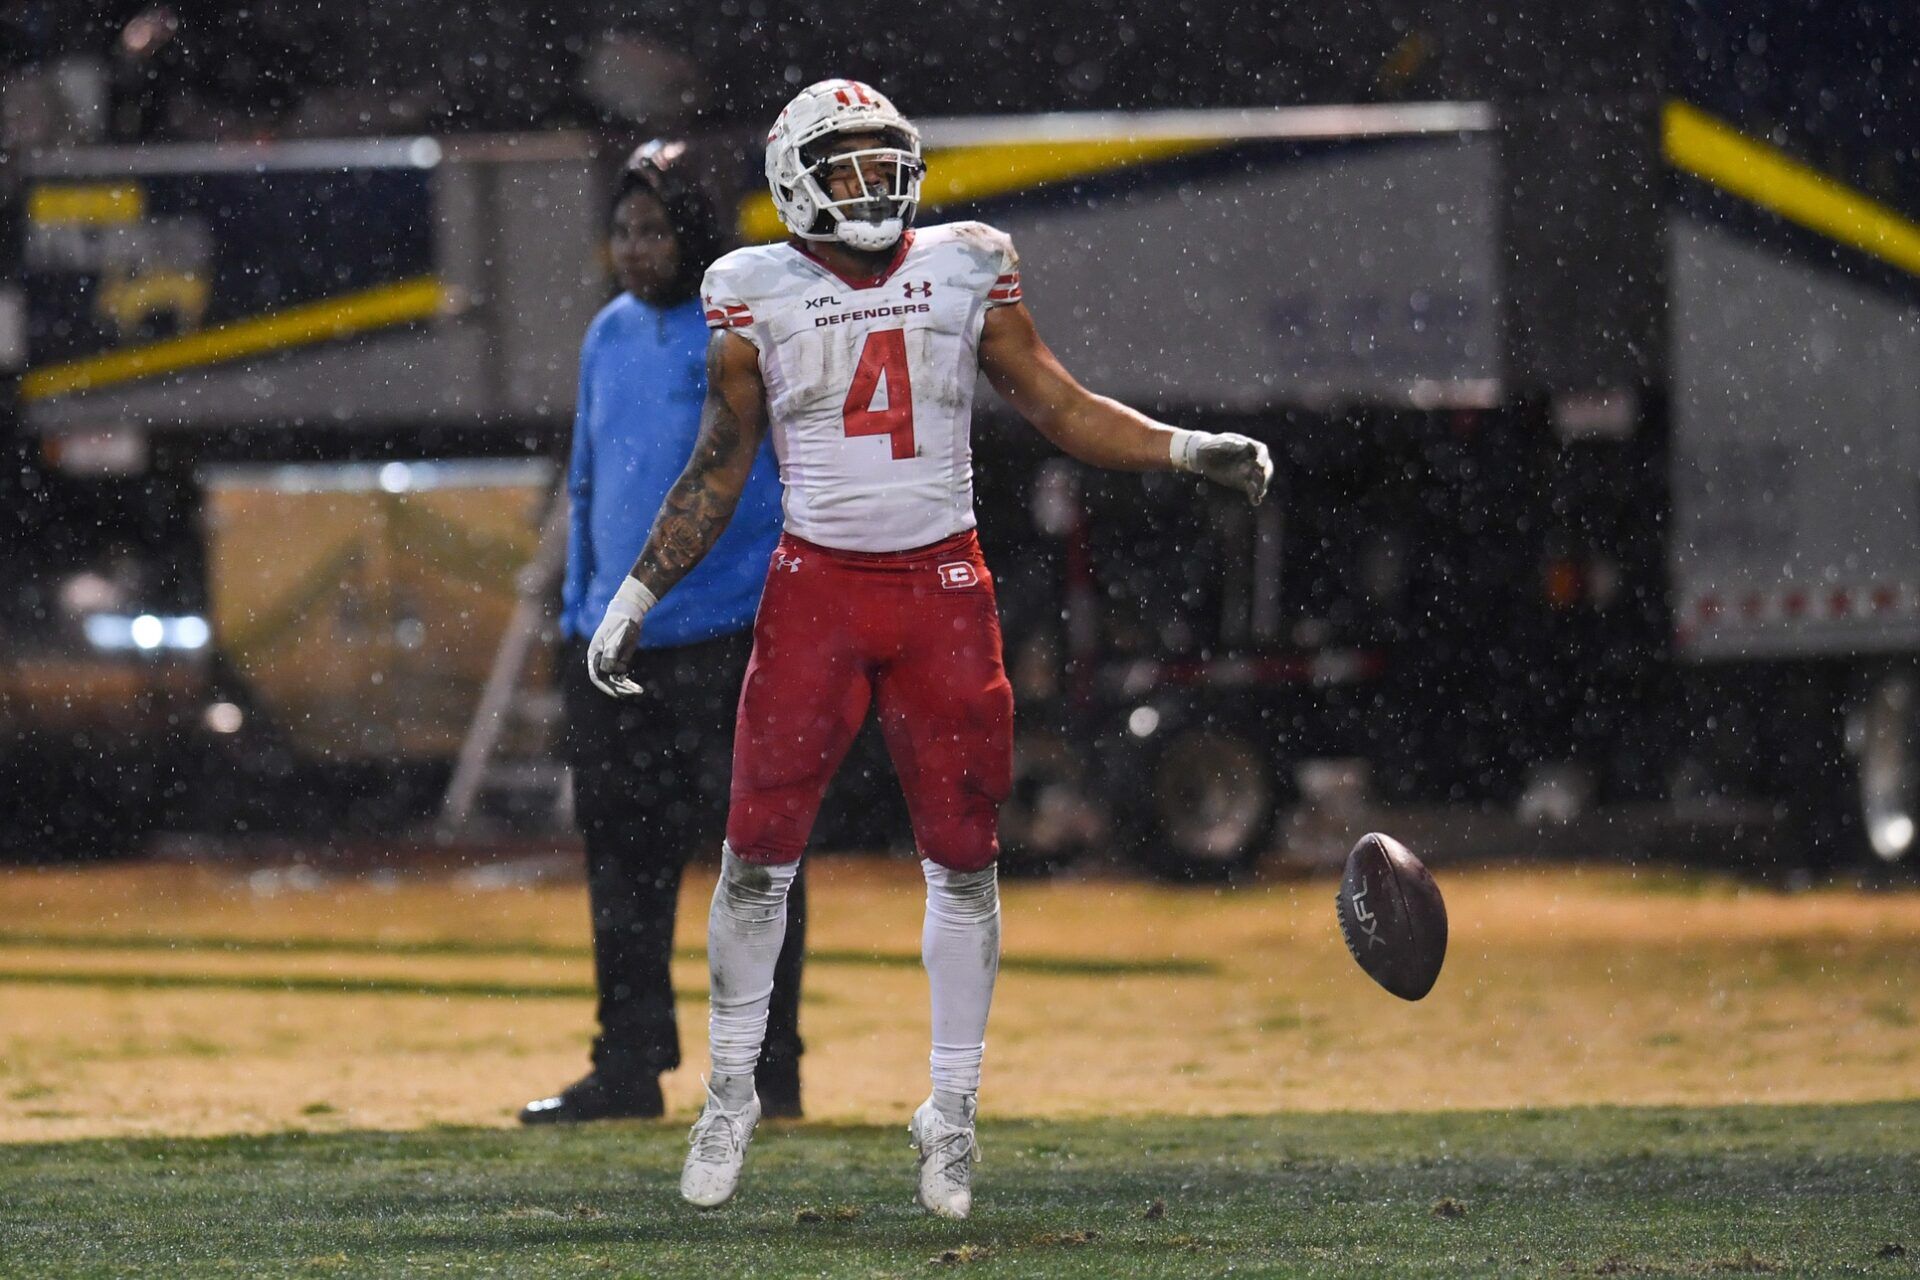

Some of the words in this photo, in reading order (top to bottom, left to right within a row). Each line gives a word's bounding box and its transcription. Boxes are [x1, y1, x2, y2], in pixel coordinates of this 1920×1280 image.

[805, 296, 842, 310] XFL
[815, 303, 931, 328] DEFENDERS
[842, 328, 916, 461] 4
[1352, 874, 1387, 951] XFL
